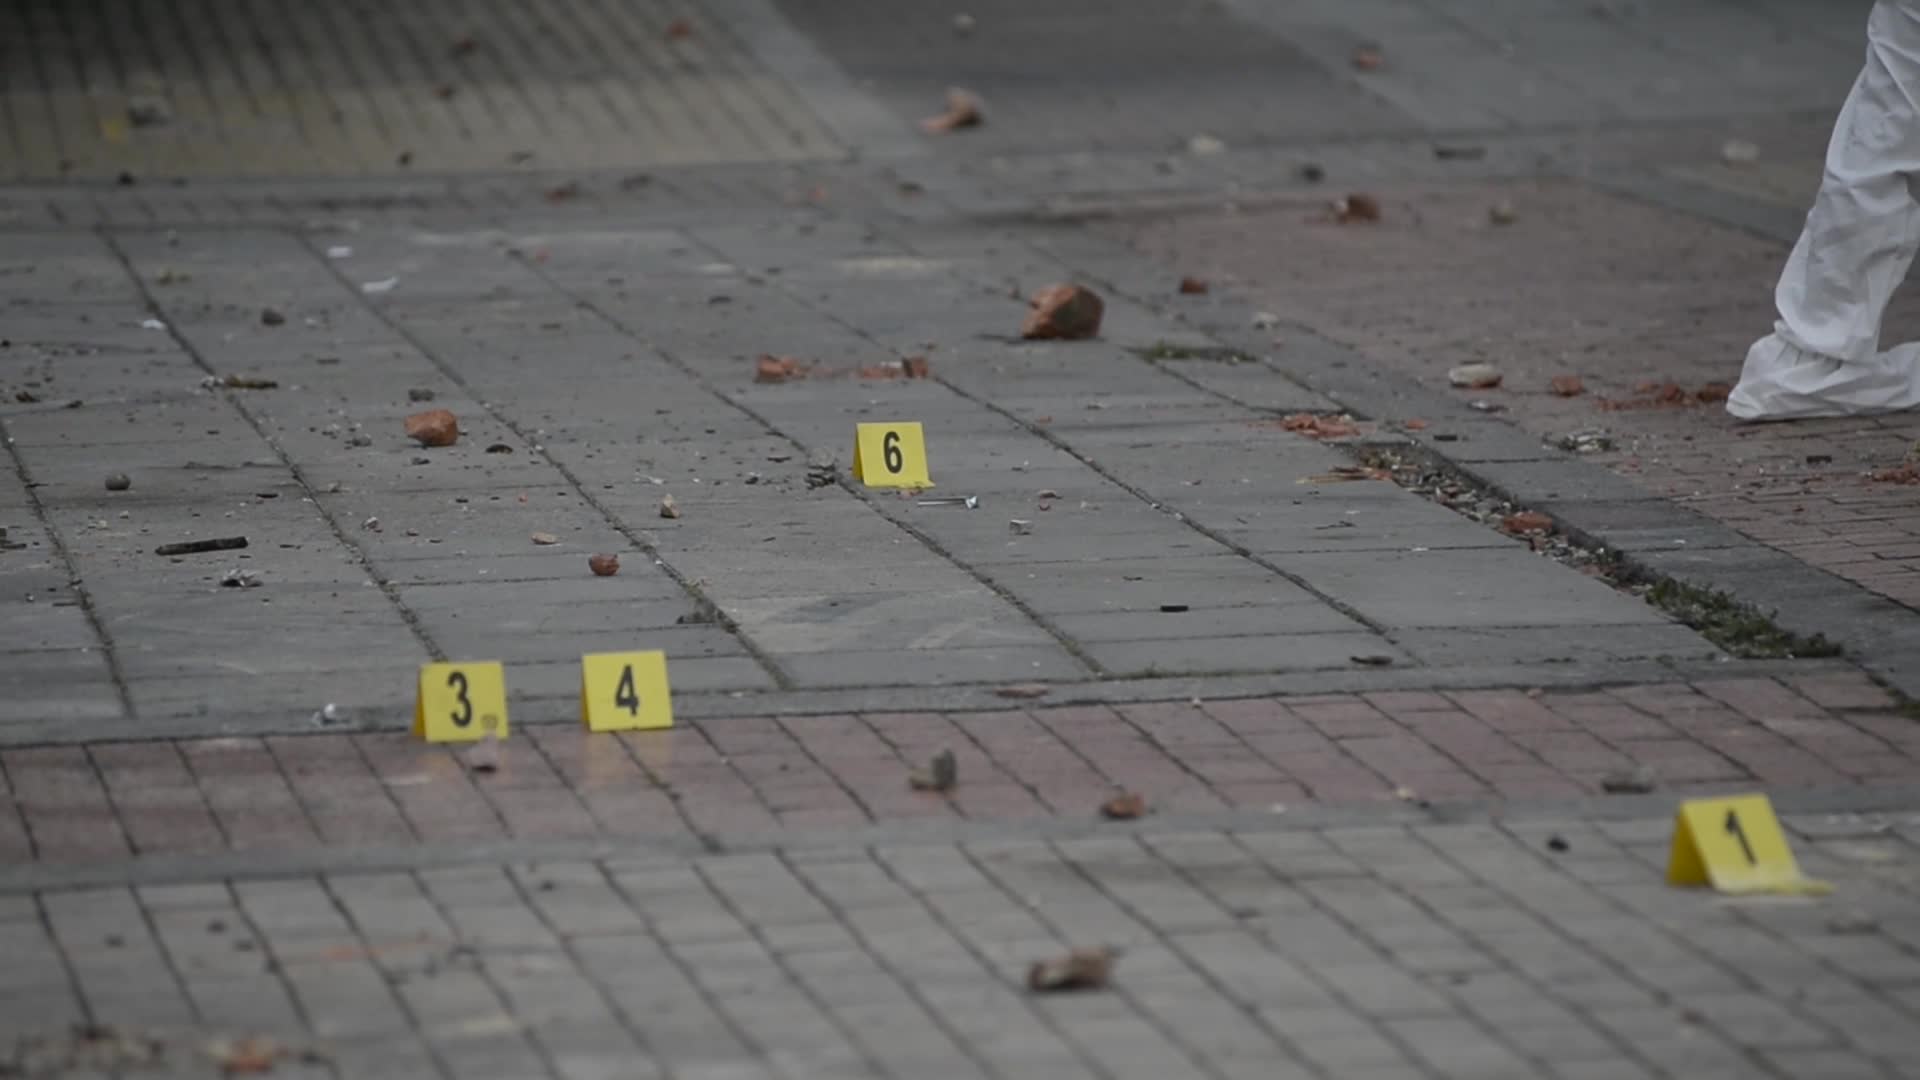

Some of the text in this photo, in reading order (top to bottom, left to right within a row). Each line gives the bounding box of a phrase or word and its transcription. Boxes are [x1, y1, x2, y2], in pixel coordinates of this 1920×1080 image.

[883, 431, 903, 474] 6
[447, 671, 473, 728] 3
[615, 665, 640, 716] 4
[1723, 810, 1757, 867] 1
